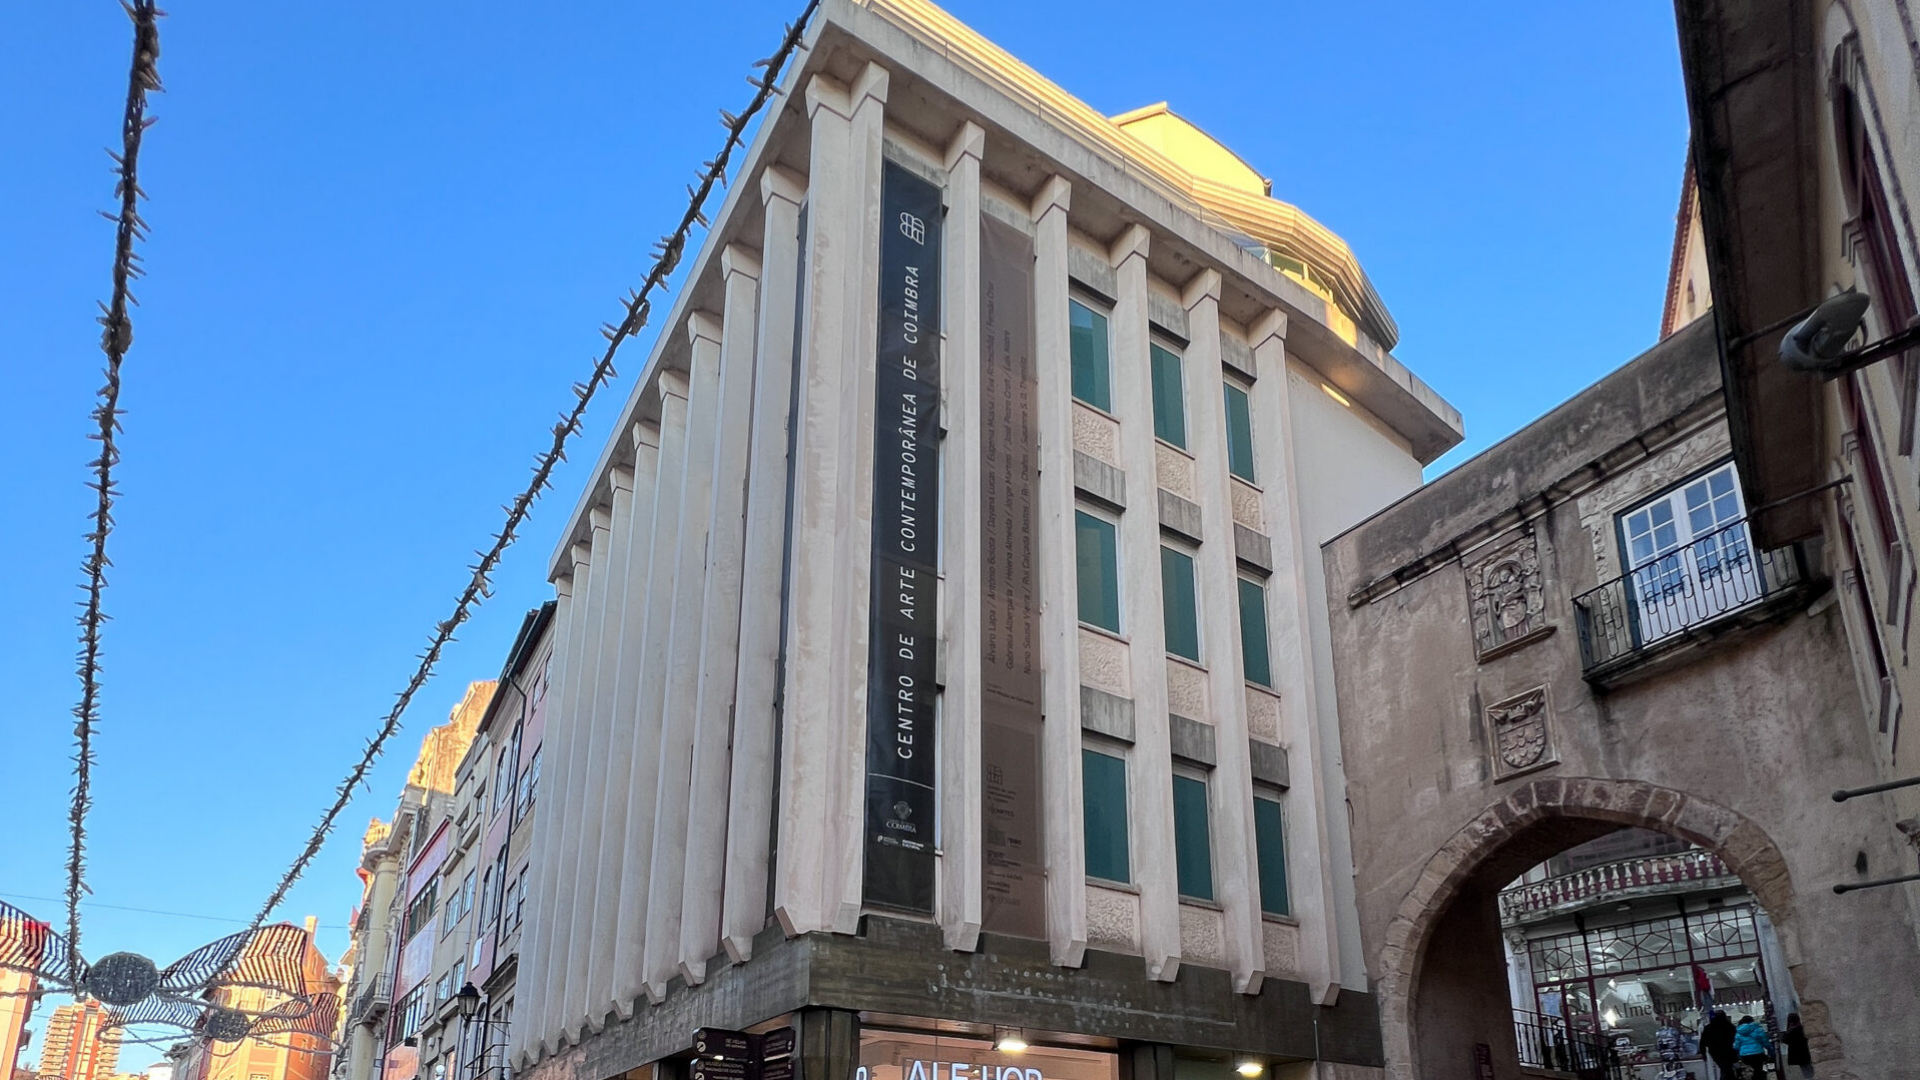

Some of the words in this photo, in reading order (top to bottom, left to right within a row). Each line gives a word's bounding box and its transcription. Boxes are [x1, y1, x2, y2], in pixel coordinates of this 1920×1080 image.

[903, 266, 919, 344] COIMBRA
[903, 355, 917, 381] DE
[898, 393, 917, 552] CONTEMPORÂNEA
[900, 566, 915, 620] ARTE
[899, 633, 914, 660] DE
[898, 675, 914, 759] CENTRO
